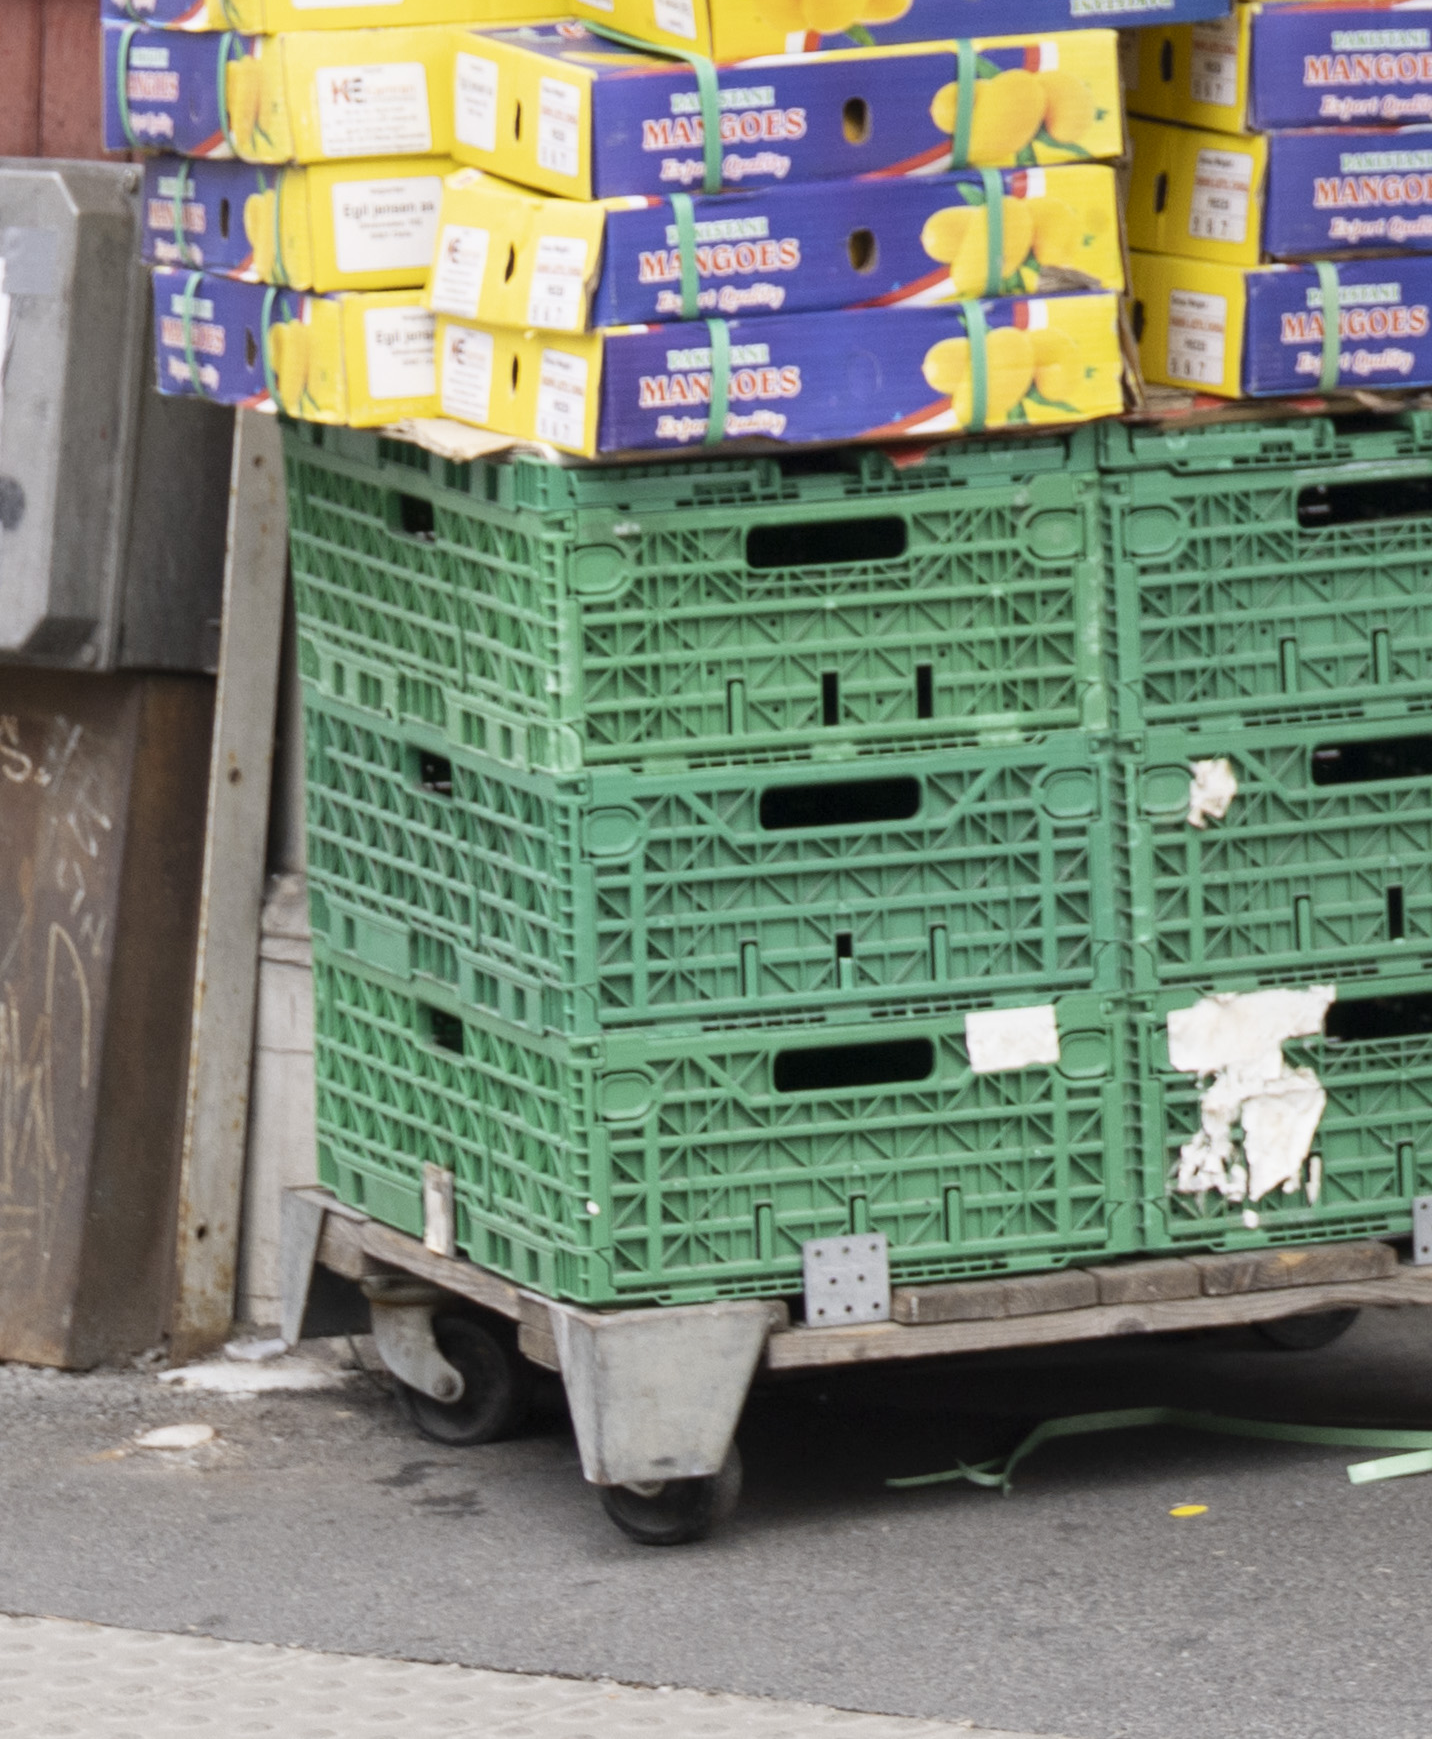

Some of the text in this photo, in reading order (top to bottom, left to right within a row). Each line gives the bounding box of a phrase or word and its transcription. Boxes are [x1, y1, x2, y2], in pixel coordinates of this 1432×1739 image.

[1331, 28, 1430, 52] PAKISTANI
[1319, 94, 1380, 121] Export
[722, 152, 792, 179] Quality
[1329, 217, 1386, 244] Export
[718, 283, 786, 311] Quality
[1352, 348, 1415, 376] Quality
